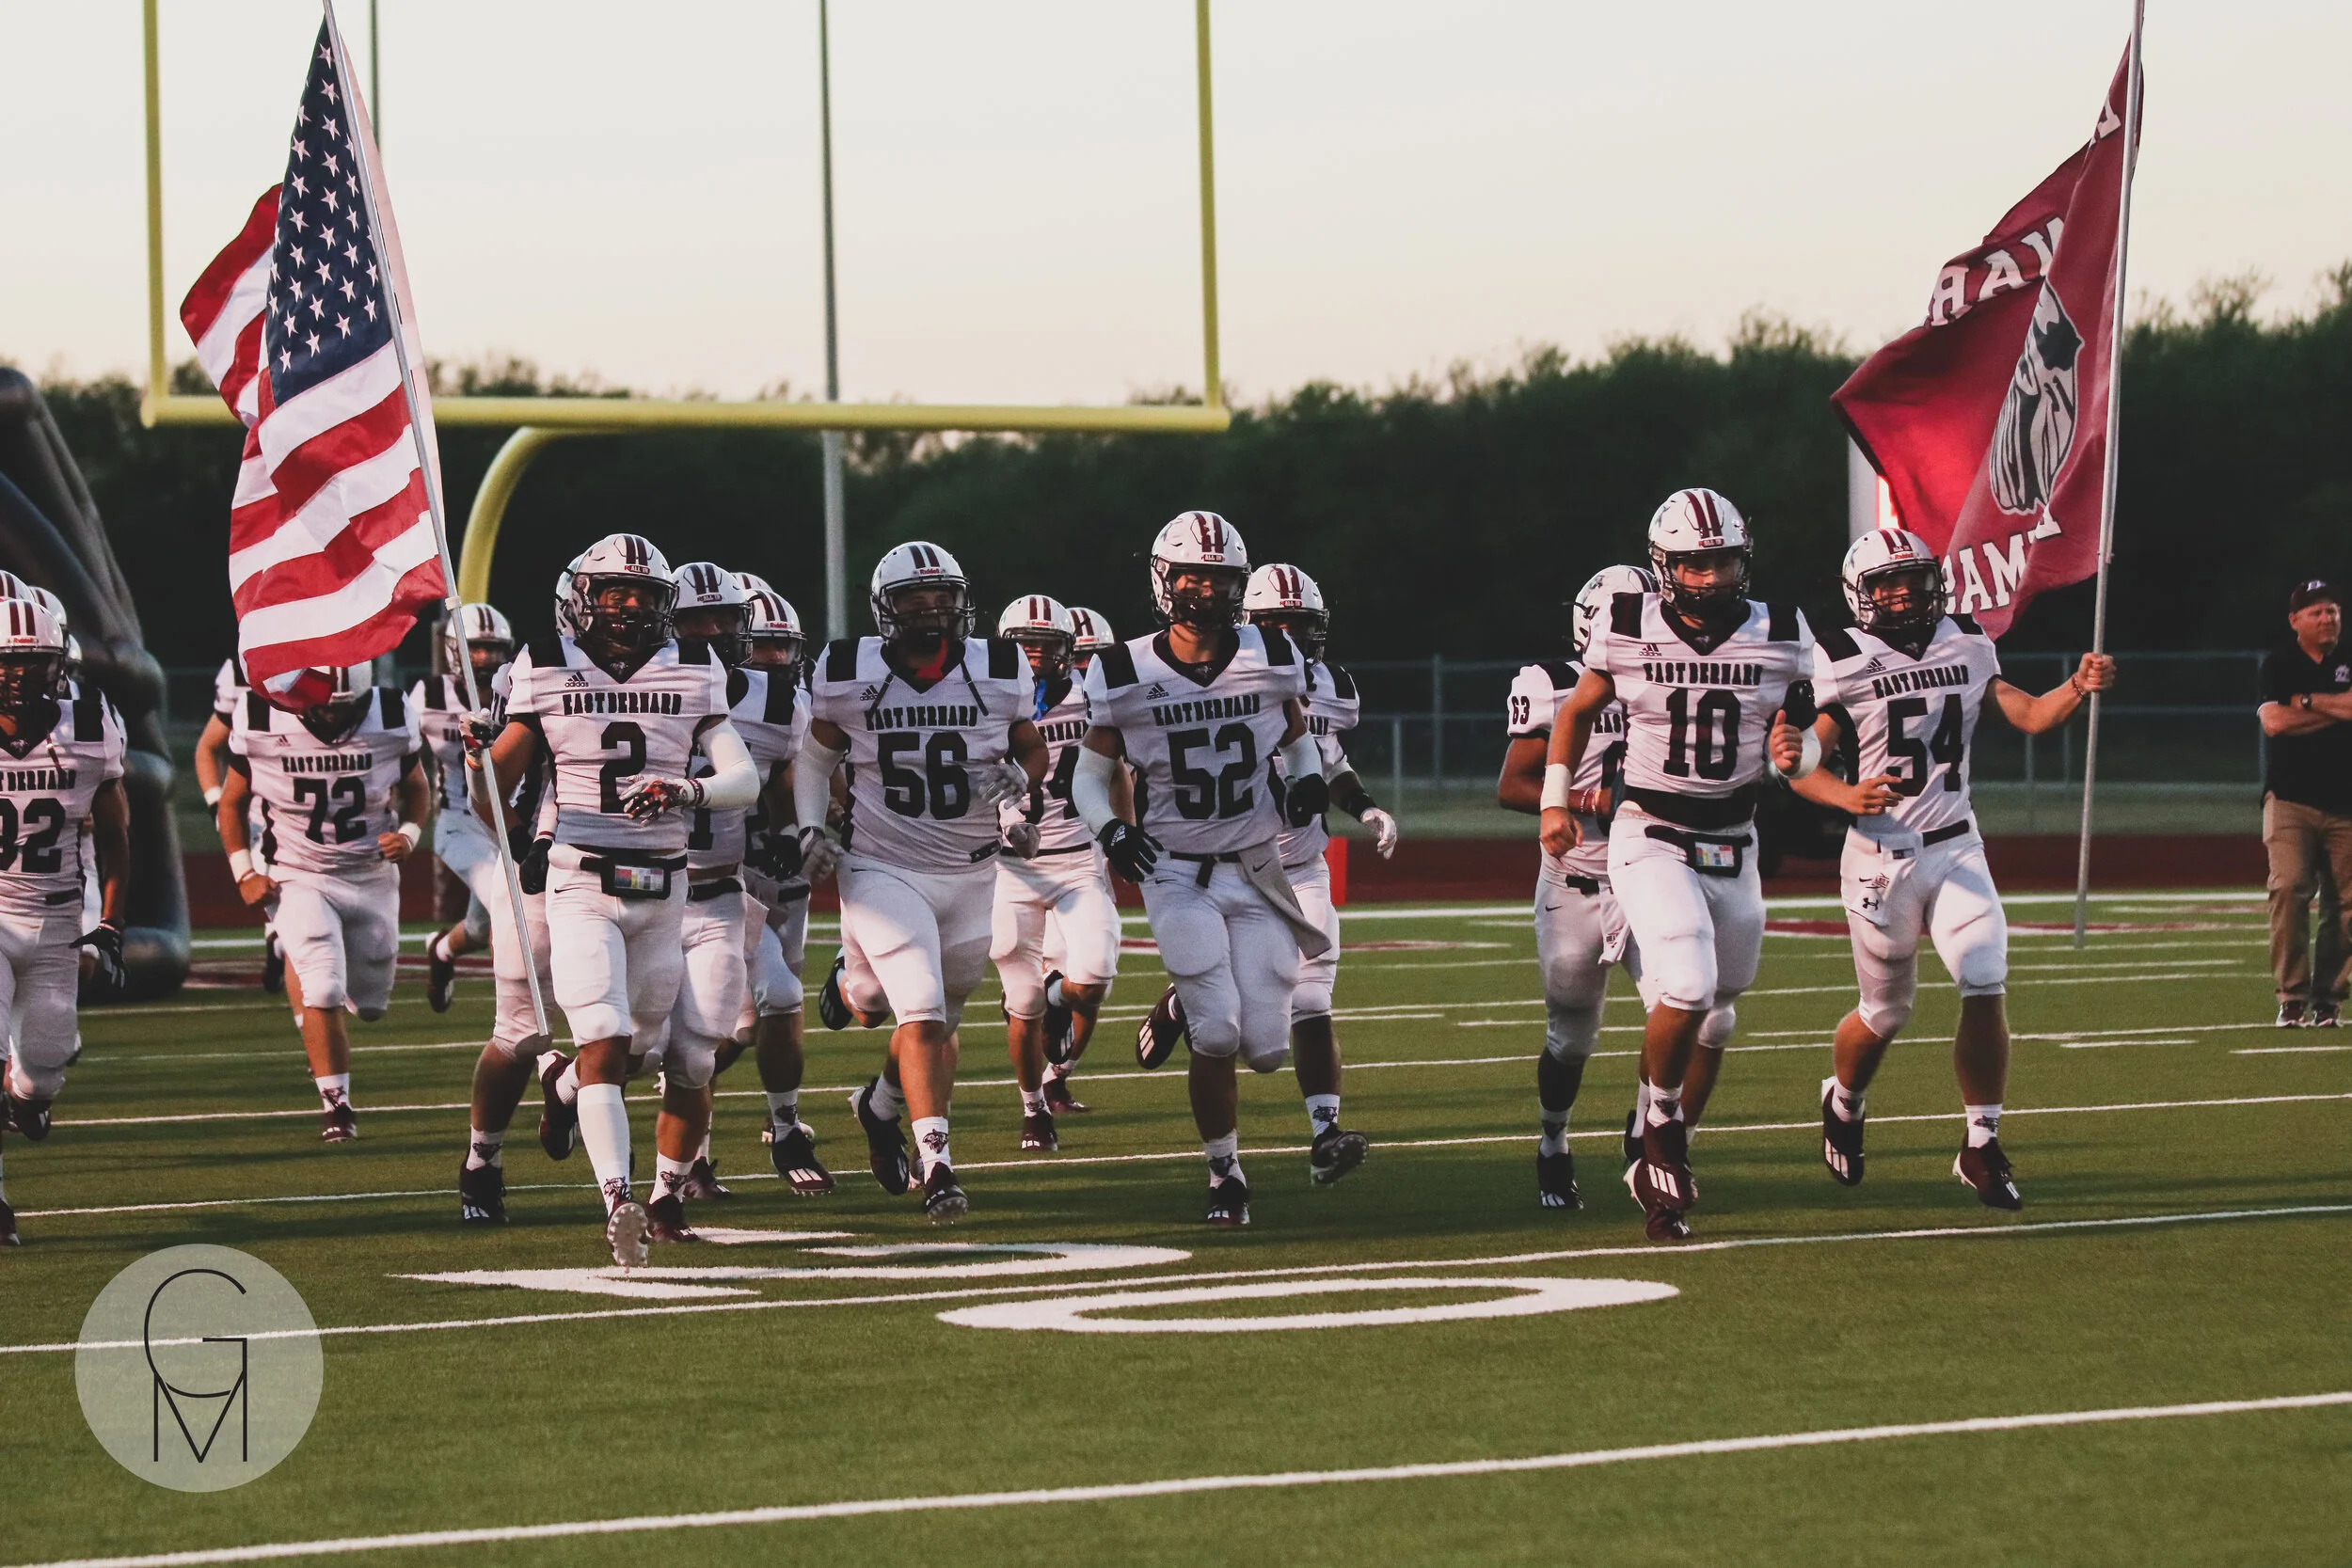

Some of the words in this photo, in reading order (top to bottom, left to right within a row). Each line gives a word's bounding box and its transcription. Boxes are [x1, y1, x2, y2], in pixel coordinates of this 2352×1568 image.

[1643, 662, 1686, 683] EAST
[1689, 662, 1763, 686] BERNARD
[1871, 673, 1911, 700] EAST
[1910, 664, 1969, 691] BERNARD
[563, 692, 606, 716] EAST
[607, 692, 682, 715] BERNARD
[1146, 691, 1169, 700] adidas
[1152, 702, 1193, 726] EAST
[1193, 693, 1260, 721] BERNARD
[1511, 696, 1531, 725] 63
[865, 706, 903, 731] EAST
[906, 705, 977, 727] BERNARD
[1663, 688, 1741, 781] 10
[1886, 693, 1963, 798] 54
[281, 756, 313, 773] EAST
[315, 753, 373, 772] BERNARD
[599, 721, 647, 814] 2
[878, 731, 970, 821] 56
[1167, 722, 1257, 820] 52
[294, 777, 367, 845] 72
